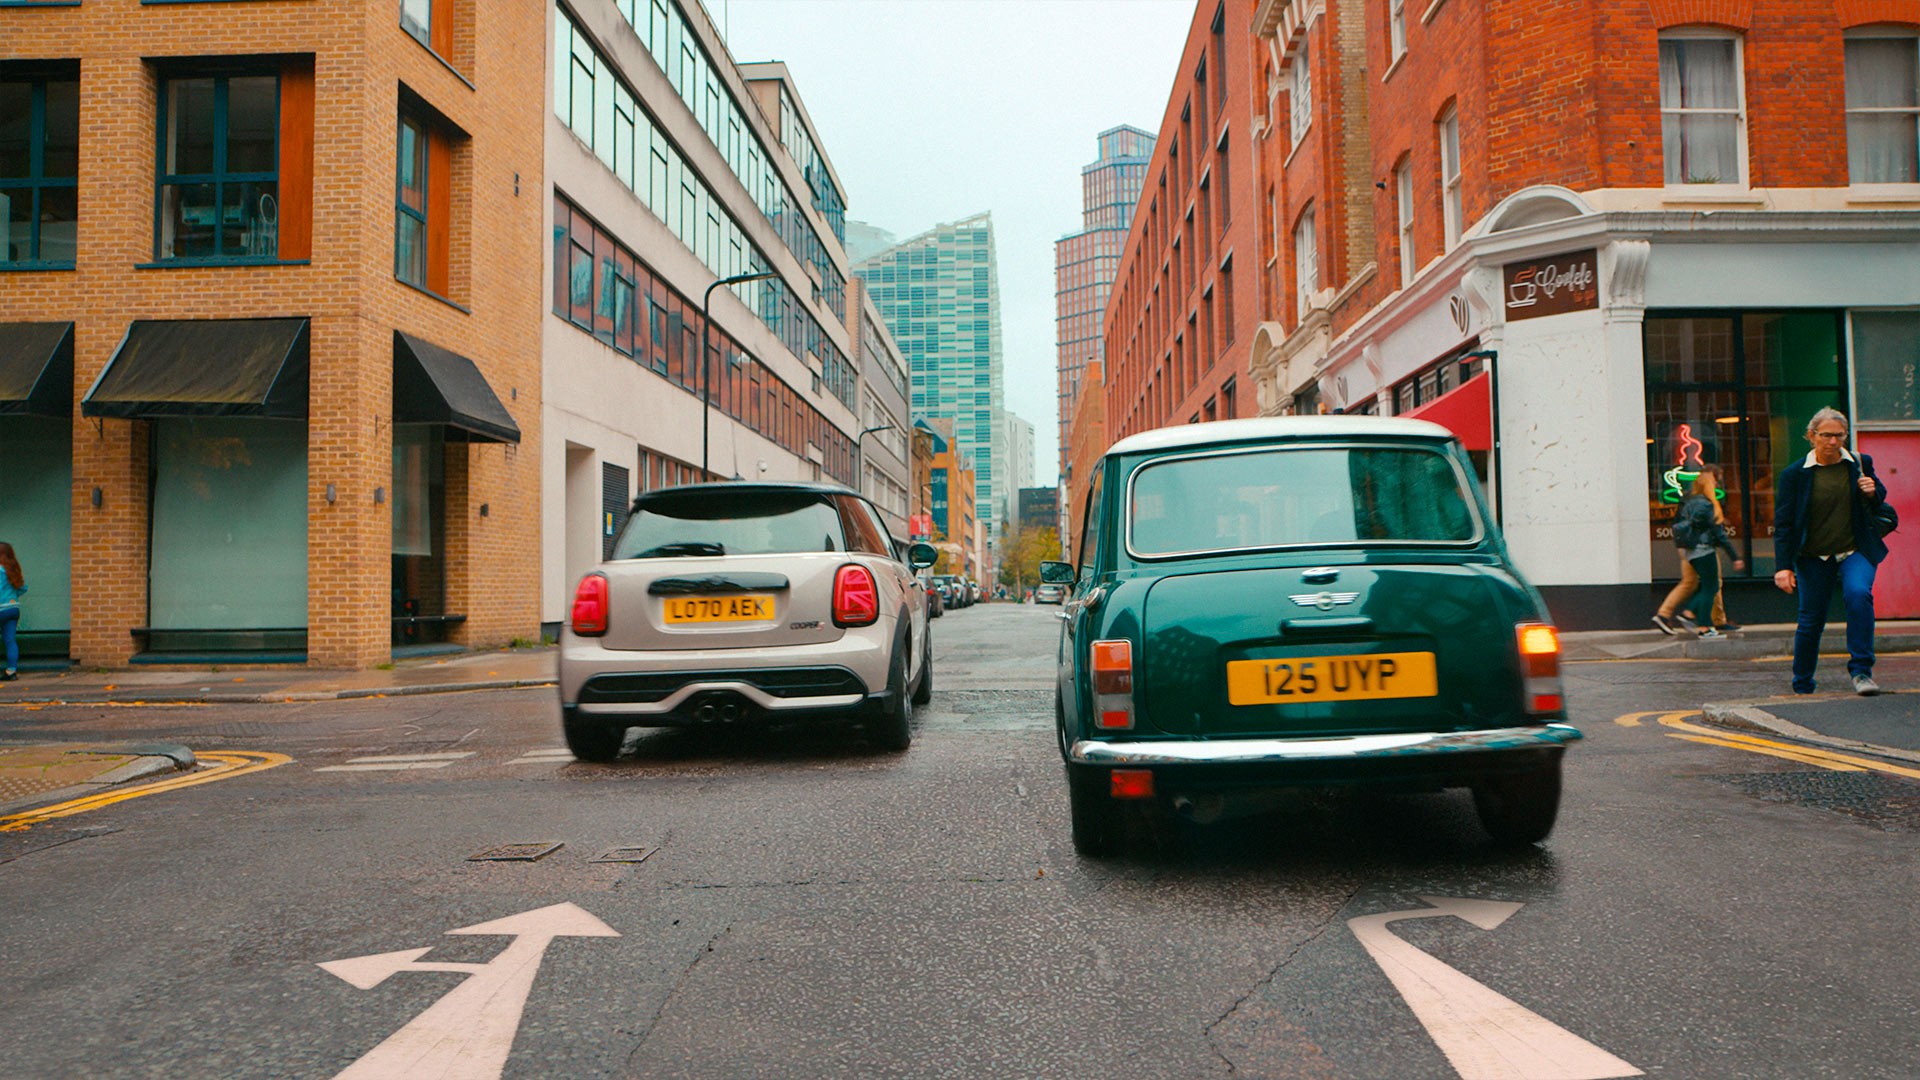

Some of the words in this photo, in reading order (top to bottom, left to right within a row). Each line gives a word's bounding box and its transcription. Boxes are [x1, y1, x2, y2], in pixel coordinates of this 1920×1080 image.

[672, 600, 722, 619] LO70
[728, 599, 766, 617] AEK
[790, 621, 819, 631] COOPER
[1264, 662, 1319, 696] 125
[1329, 659, 1397, 692] UYP
